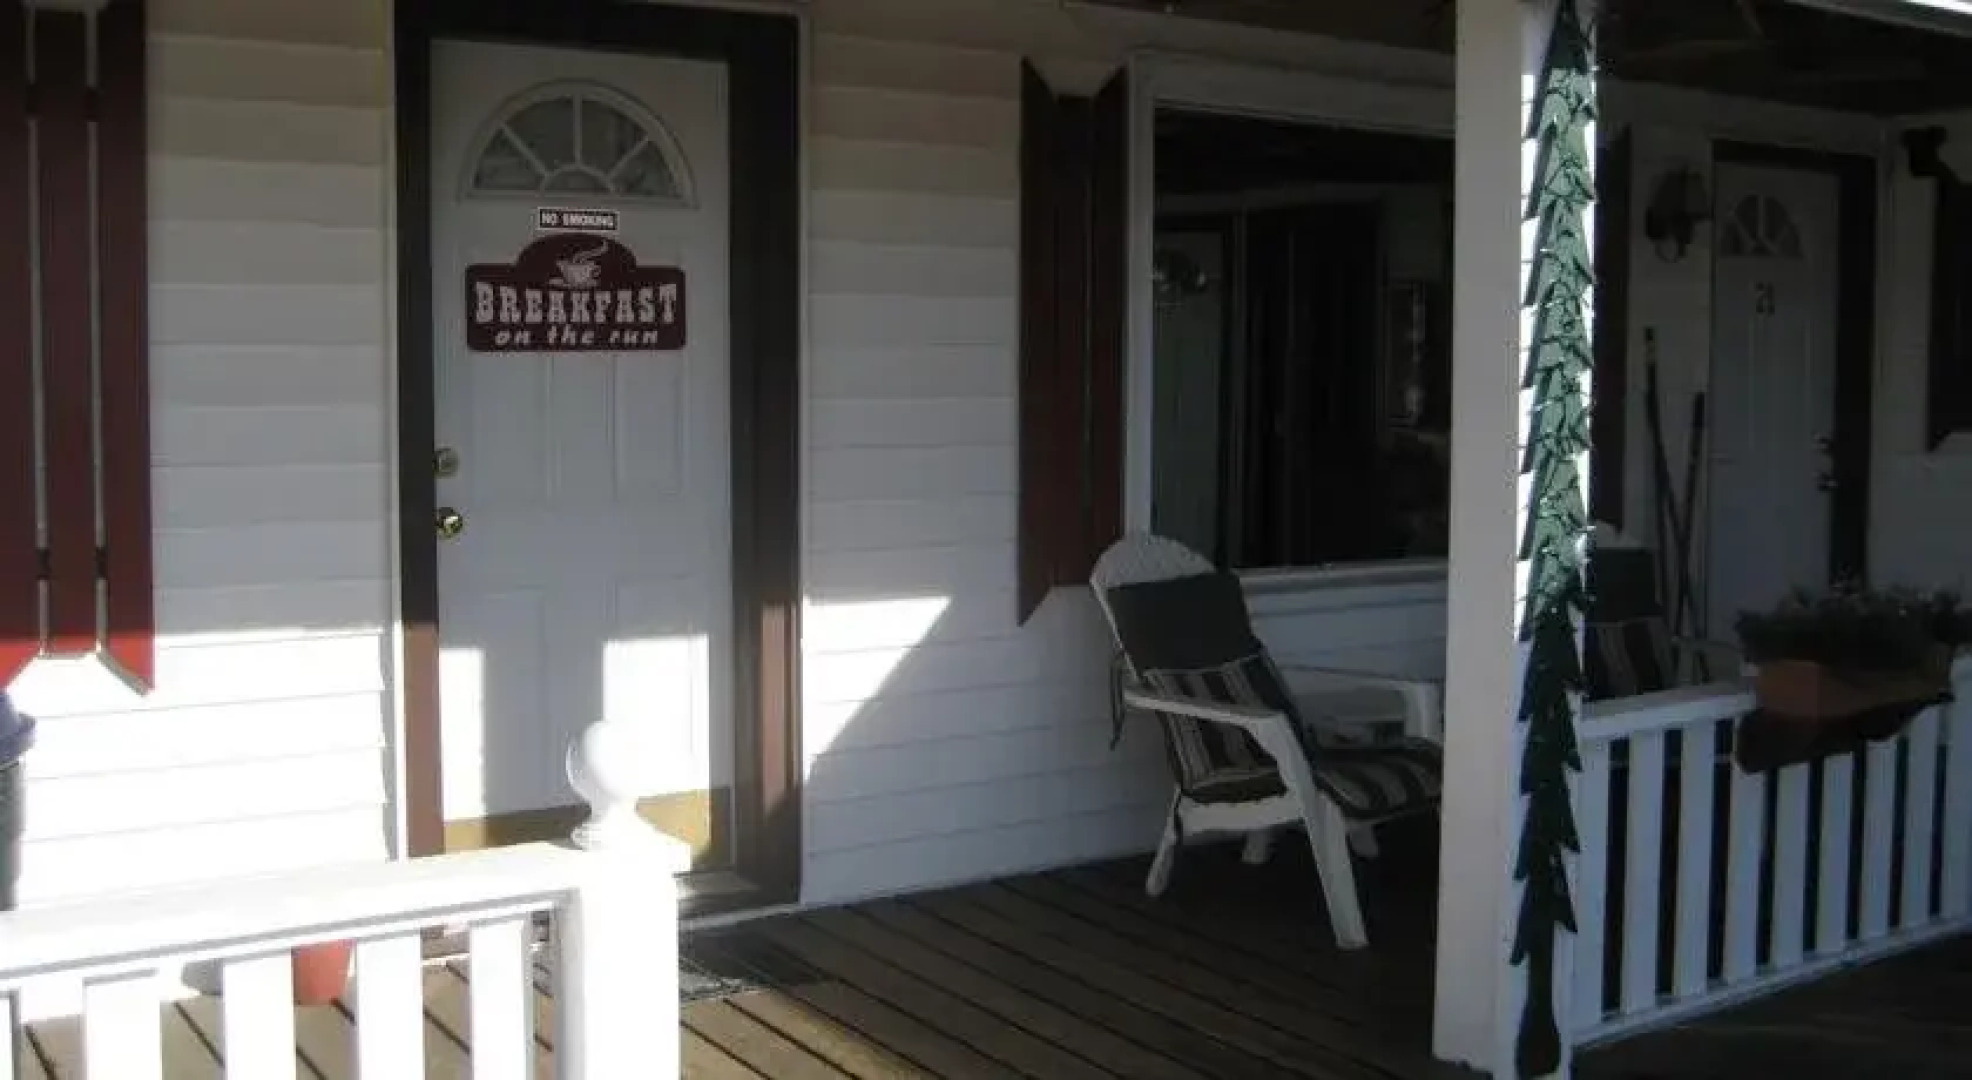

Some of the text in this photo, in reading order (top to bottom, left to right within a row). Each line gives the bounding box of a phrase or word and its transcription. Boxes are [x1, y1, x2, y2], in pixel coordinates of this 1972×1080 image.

[541, 213, 614, 228] NO SMOKING
[475, 281, 677, 324] BREAKFAST
[495, 325, 658, 345] on the run
